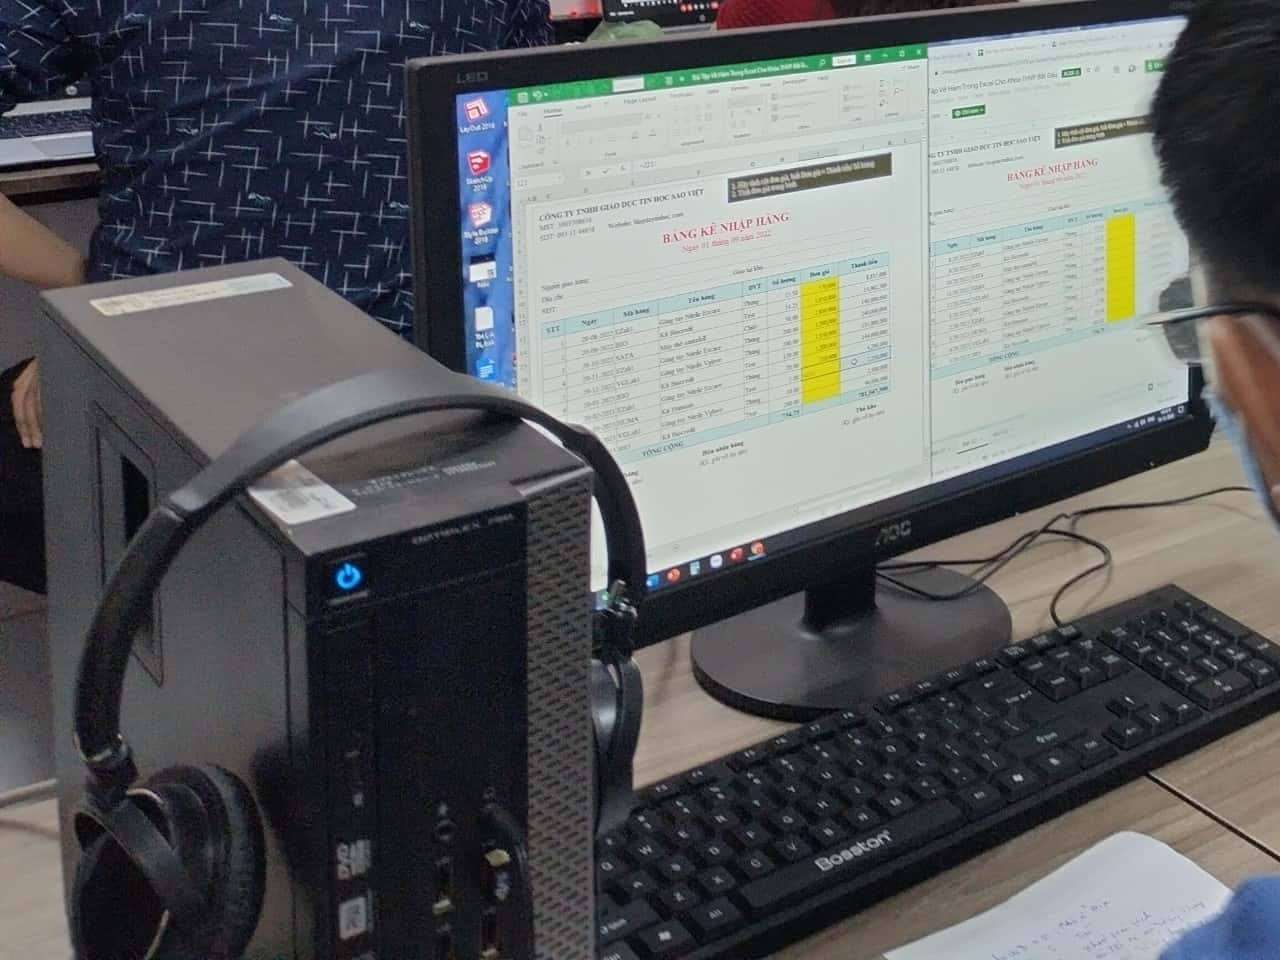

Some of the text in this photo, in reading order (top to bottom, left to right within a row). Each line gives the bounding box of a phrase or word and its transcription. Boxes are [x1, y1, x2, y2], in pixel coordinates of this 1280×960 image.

[565, 210, 574, 218] TY
[663, 210, 790, 244] BẢNG KÊ NHẬP HÀNG
[814, 829, 893, 872] Bosston
